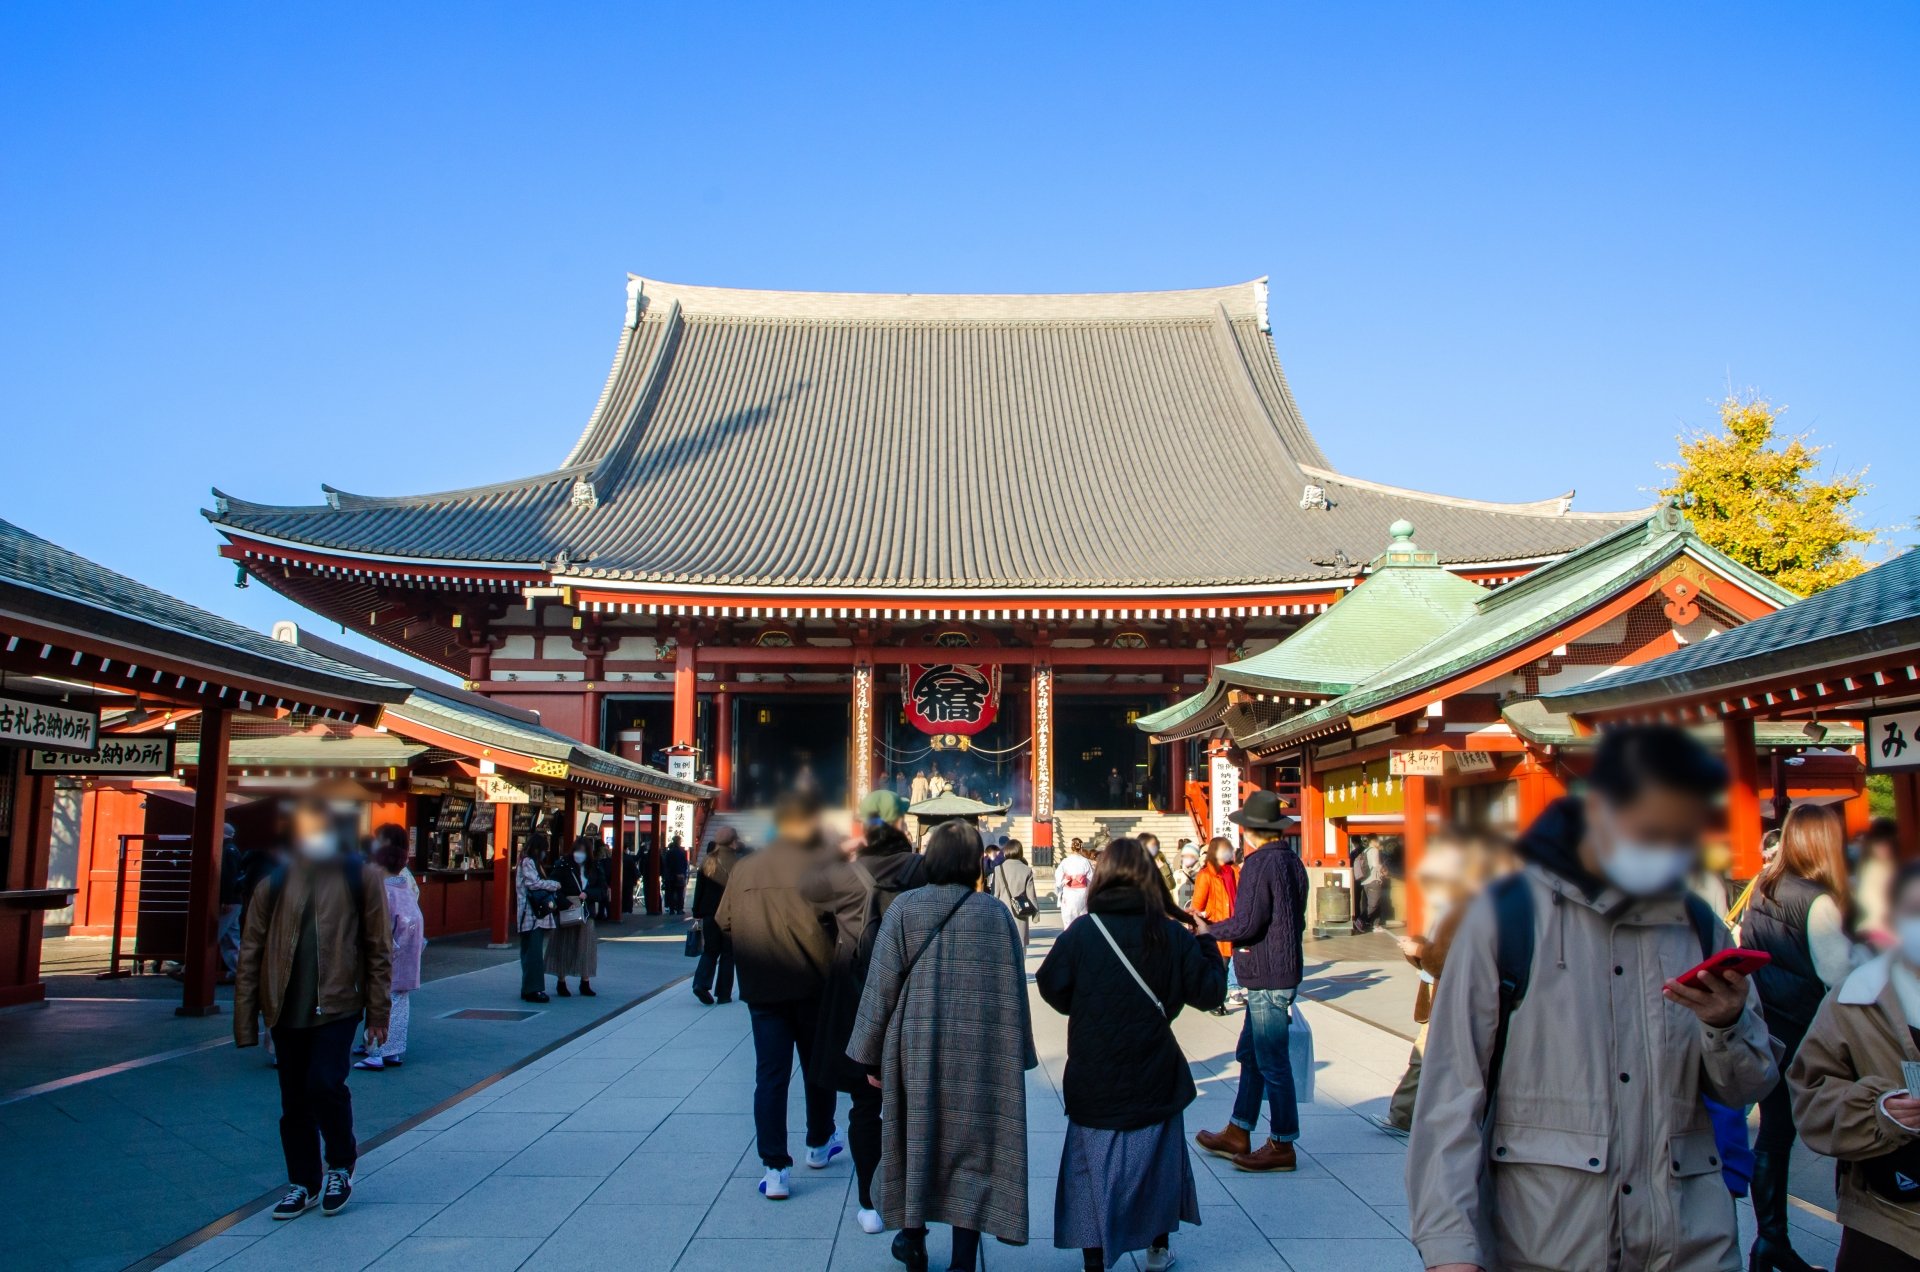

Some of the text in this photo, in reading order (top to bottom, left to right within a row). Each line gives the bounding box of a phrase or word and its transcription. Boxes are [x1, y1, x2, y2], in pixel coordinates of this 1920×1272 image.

[0, 704, 91, 743] 古札お納め所
[1407, 750, 1440, 766] 朱印所
